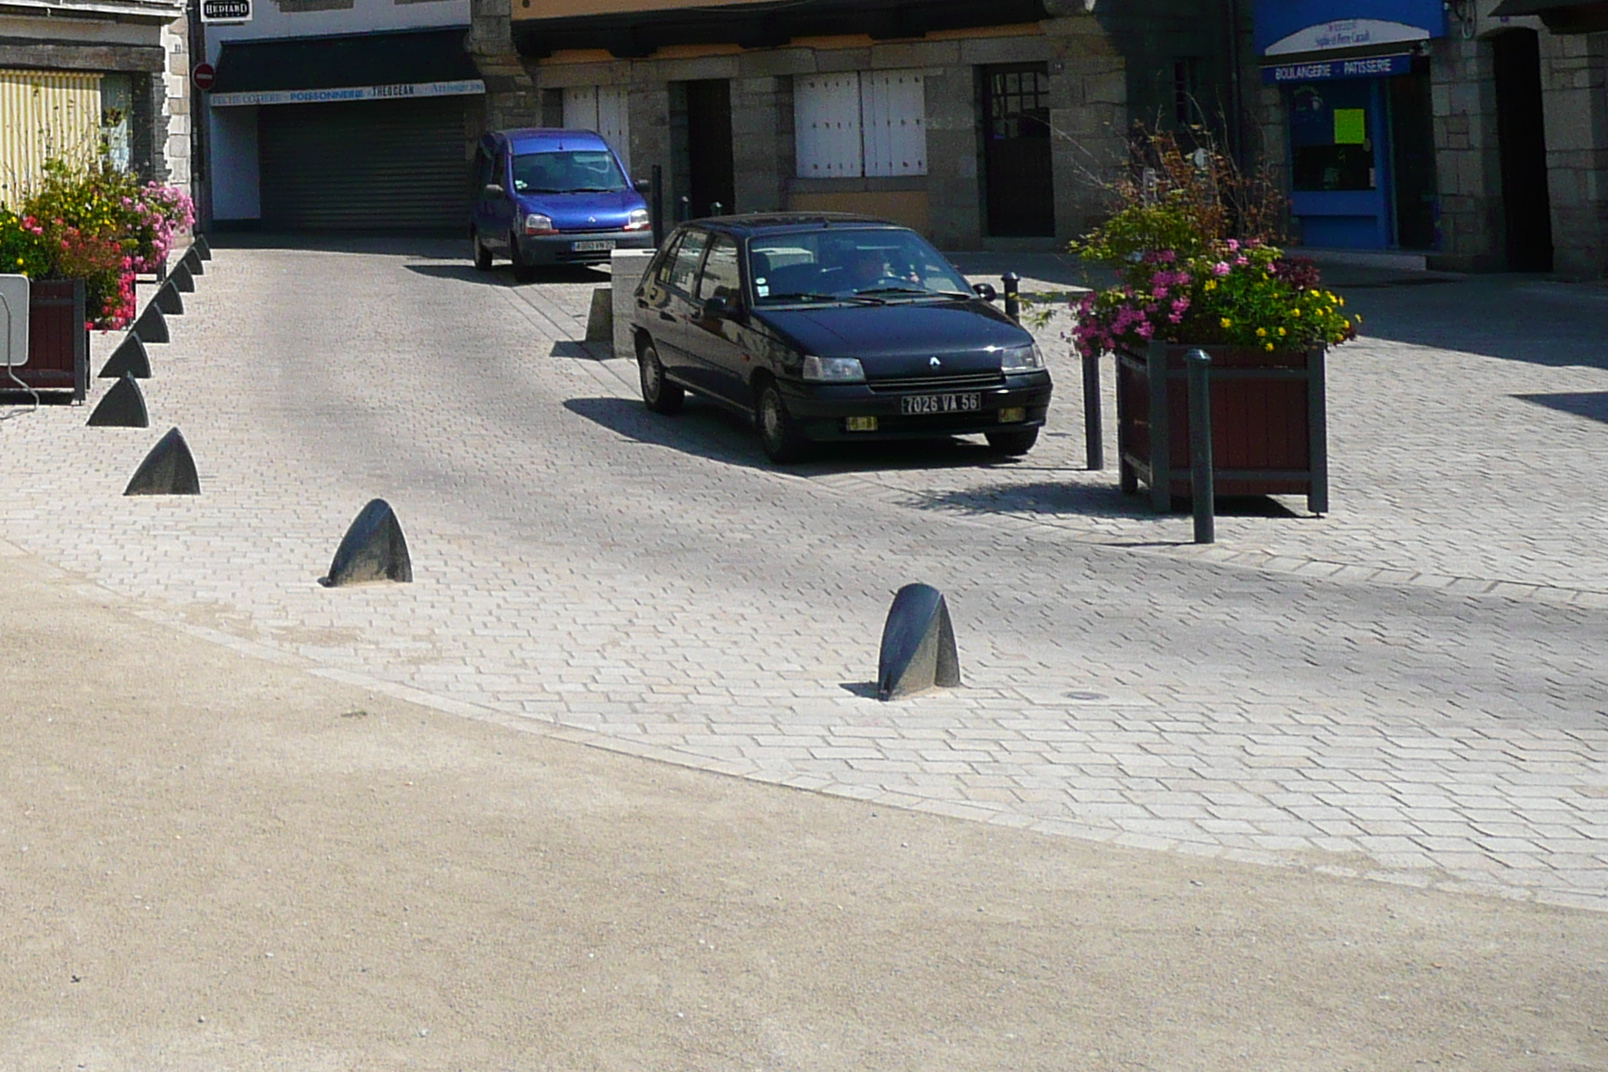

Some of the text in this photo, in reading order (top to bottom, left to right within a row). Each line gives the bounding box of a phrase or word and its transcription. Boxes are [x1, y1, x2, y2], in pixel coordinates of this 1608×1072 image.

[206, 3, 248, 14] HEDIARD
[1275, 64, 1332, 80] BOULANGERIE
[1344, 59, 1392, 75] PATISSERIE
[290, 89, 364, 101] POISSONNERIE
[907, 393, 977, 413] 7026 VA 56
